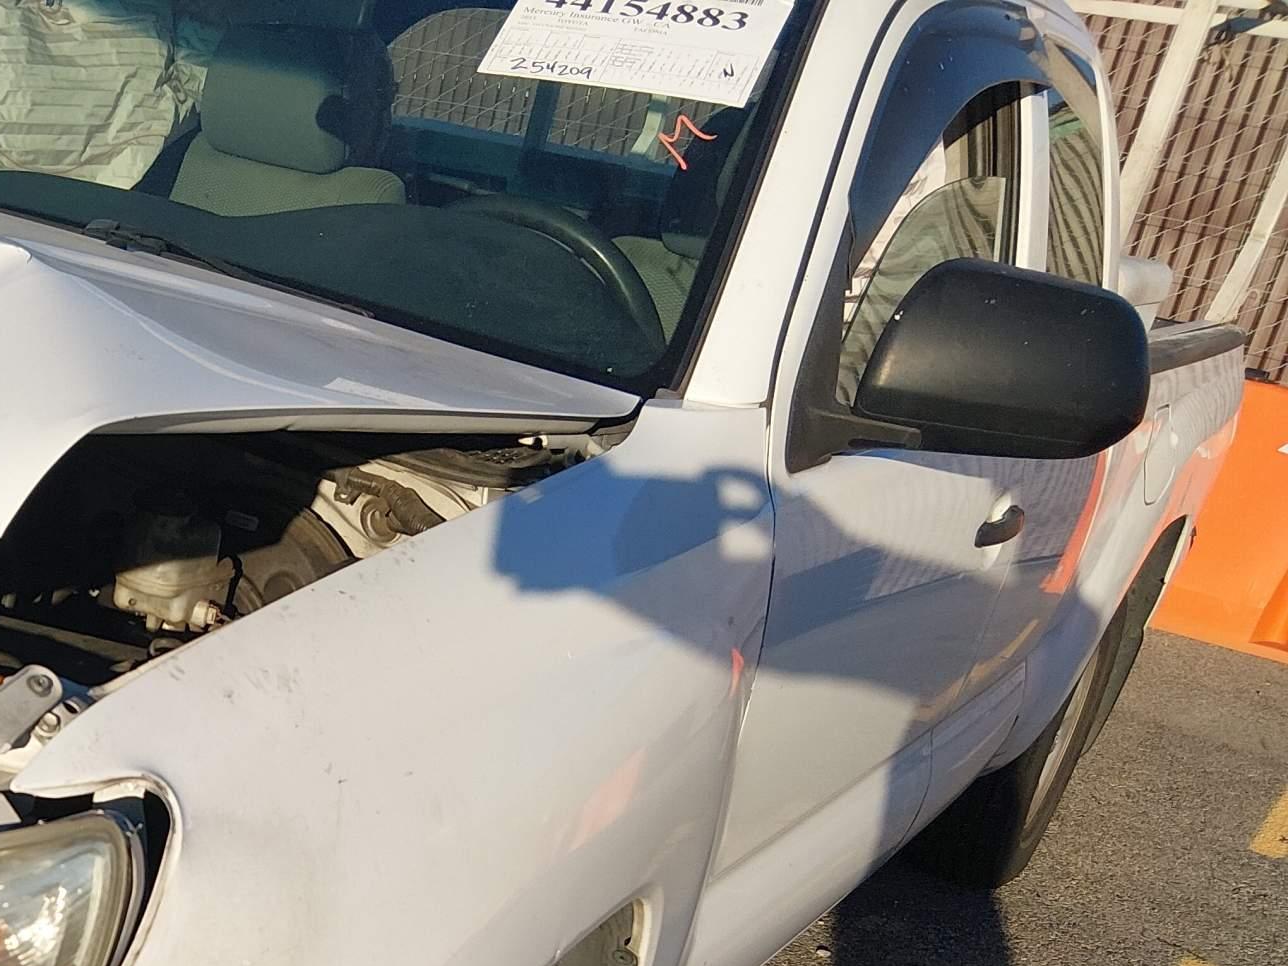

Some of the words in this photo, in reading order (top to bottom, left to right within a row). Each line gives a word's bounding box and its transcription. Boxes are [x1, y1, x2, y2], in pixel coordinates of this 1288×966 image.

[523, 6, 566, 19] Mercury
[569, 10, 620, 24] Insurance
[510, 57, 594, 80] 254209
